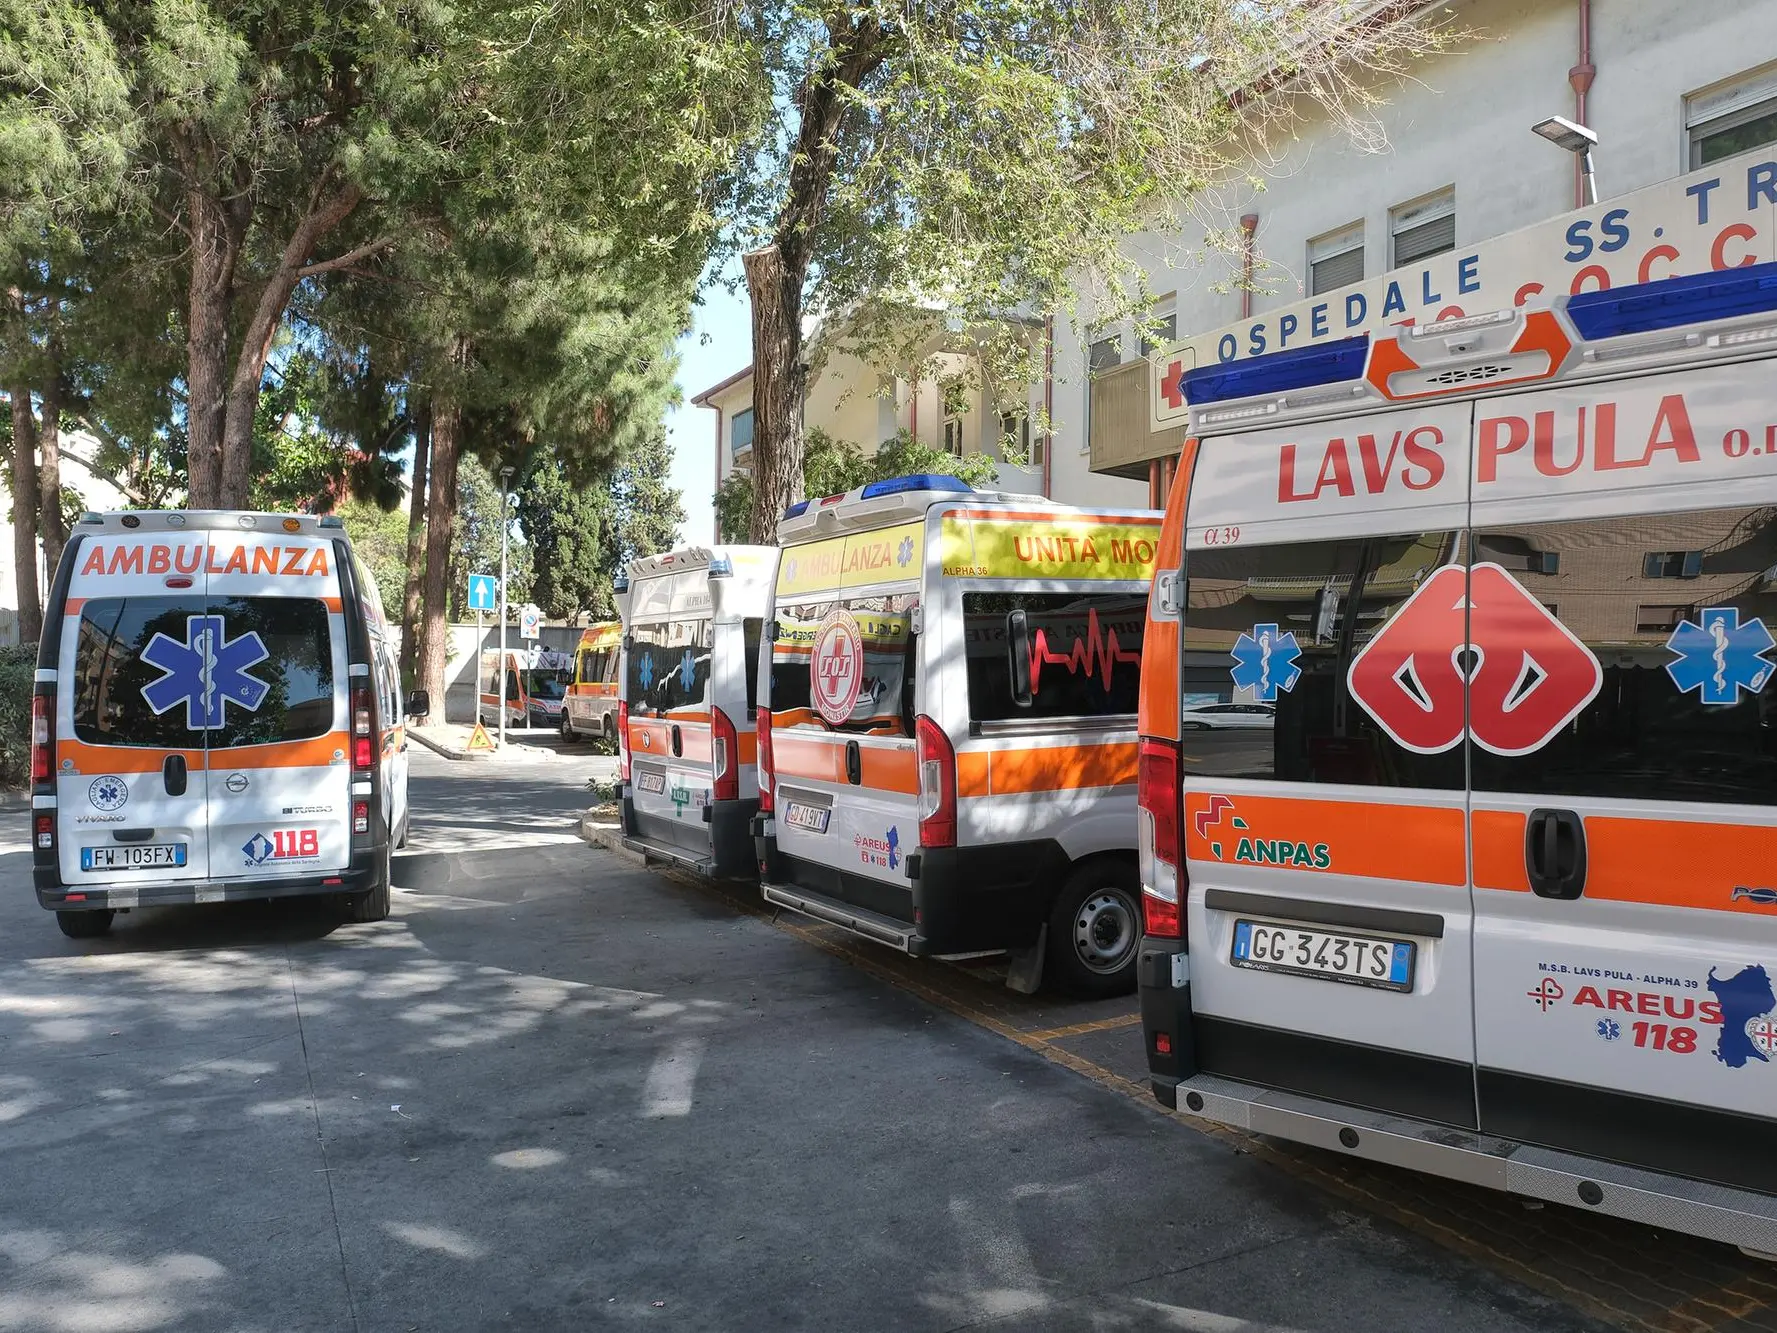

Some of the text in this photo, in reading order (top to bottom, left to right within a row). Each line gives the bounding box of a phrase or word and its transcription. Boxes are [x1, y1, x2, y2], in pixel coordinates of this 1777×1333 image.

[1218, 254, 1480, 362] OSPEDALE
[1278, 424, 1445, 503] LAVS
[1478, 394, 1701, 484] PULA
[1013, 536, 1159, 565] UNITÀ MO
[1222, 527, 1240, 545] 39
[81, 545, 329, 577] AMBULANZA
[802, 543, 892, 577] AMBULANZA
[942, 566, 988, 577] ALPHA 36
[104, 777, 127, 808] EMERGENZA
[75, 815, 126, 824] VIVARO
[95, 849, 115, 866] FW
[124, 846, 174, 865] 103FX
[273, 830, 319, 857] 118
[862, 838, 891, 853] AREUS
[1236, 838, 1331, 869] ANPAS
[876, 856, 887, 867] 118
[1252, 929, 1286, 962] GG
[1295, 934, 1388, 977] 343TS
[1538, 962, 1571, 975] M.S.B.
[1573, 966, 1601, 978] LAVS
[1604, 970, 1634, 982] PULA
[1643, 974, 1681, 987] ALPHA
[1684, 979, 1699, 989] 39
[1572, 986, 1725, 1025] AREUS
[1632, 1021, 1698, 1054] 118
